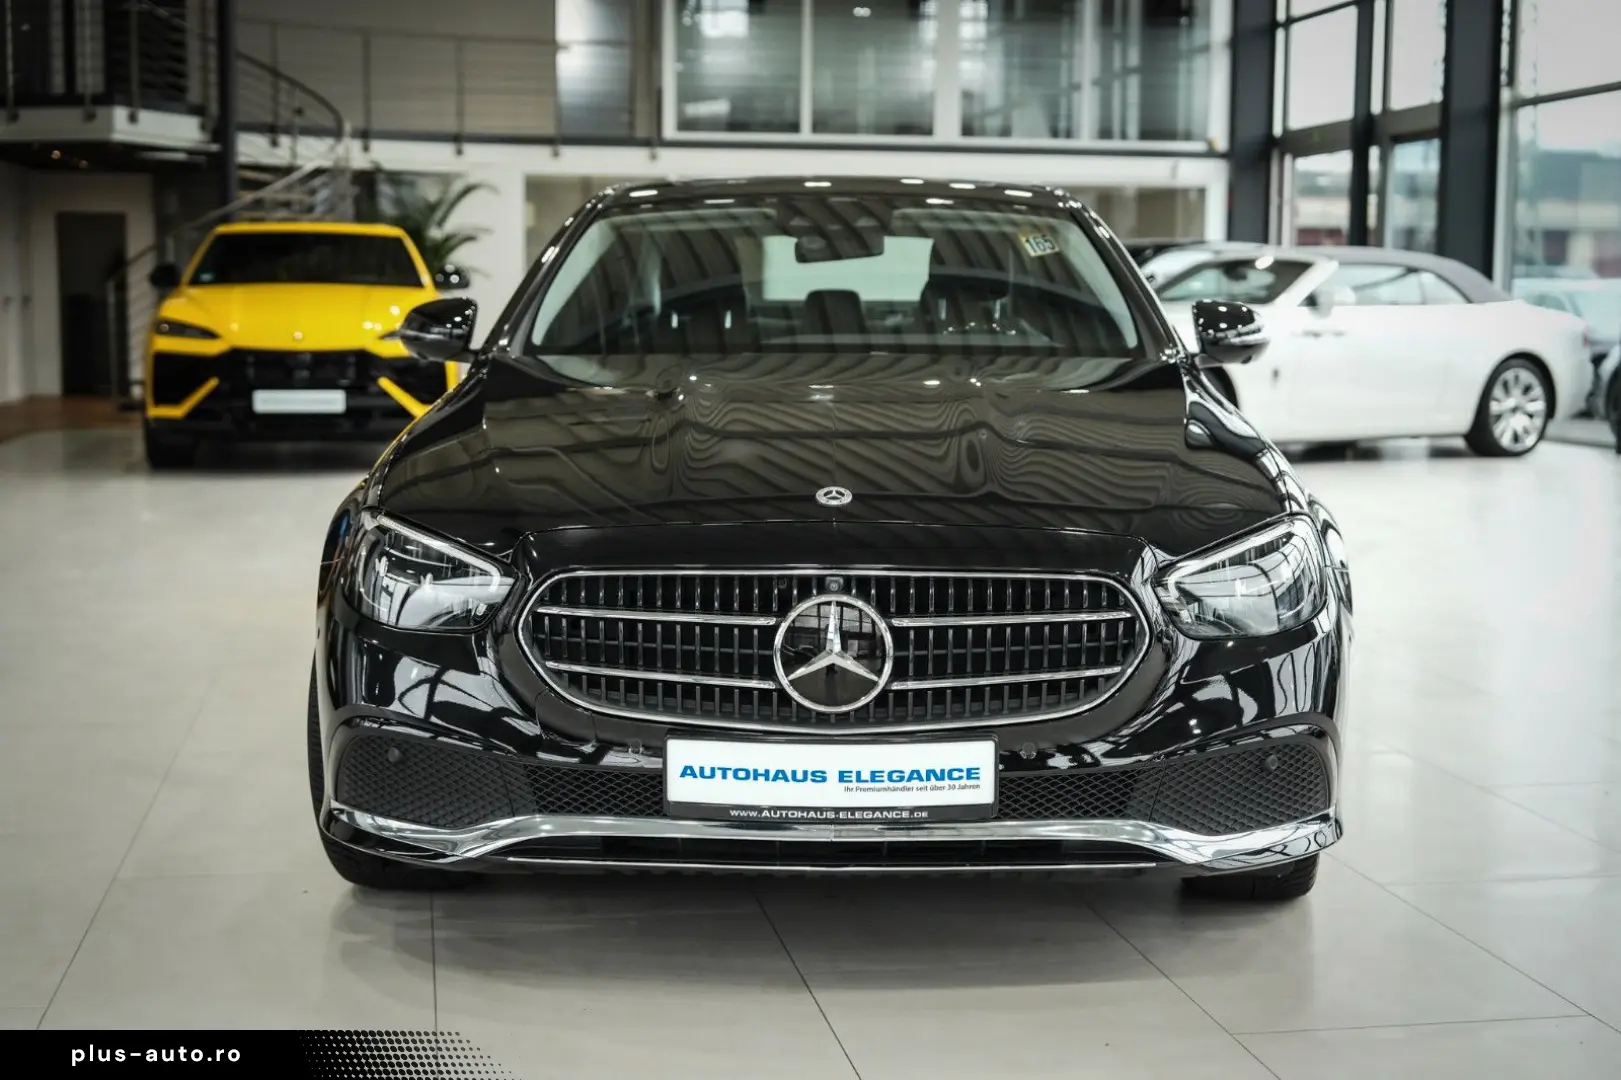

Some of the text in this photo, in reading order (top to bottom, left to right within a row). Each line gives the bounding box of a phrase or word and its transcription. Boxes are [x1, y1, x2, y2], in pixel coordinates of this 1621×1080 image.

[679, 765, 981, 783] AUTOHAUS ELEGANCE
[855, 784, 914, 793] Premiumhändler
